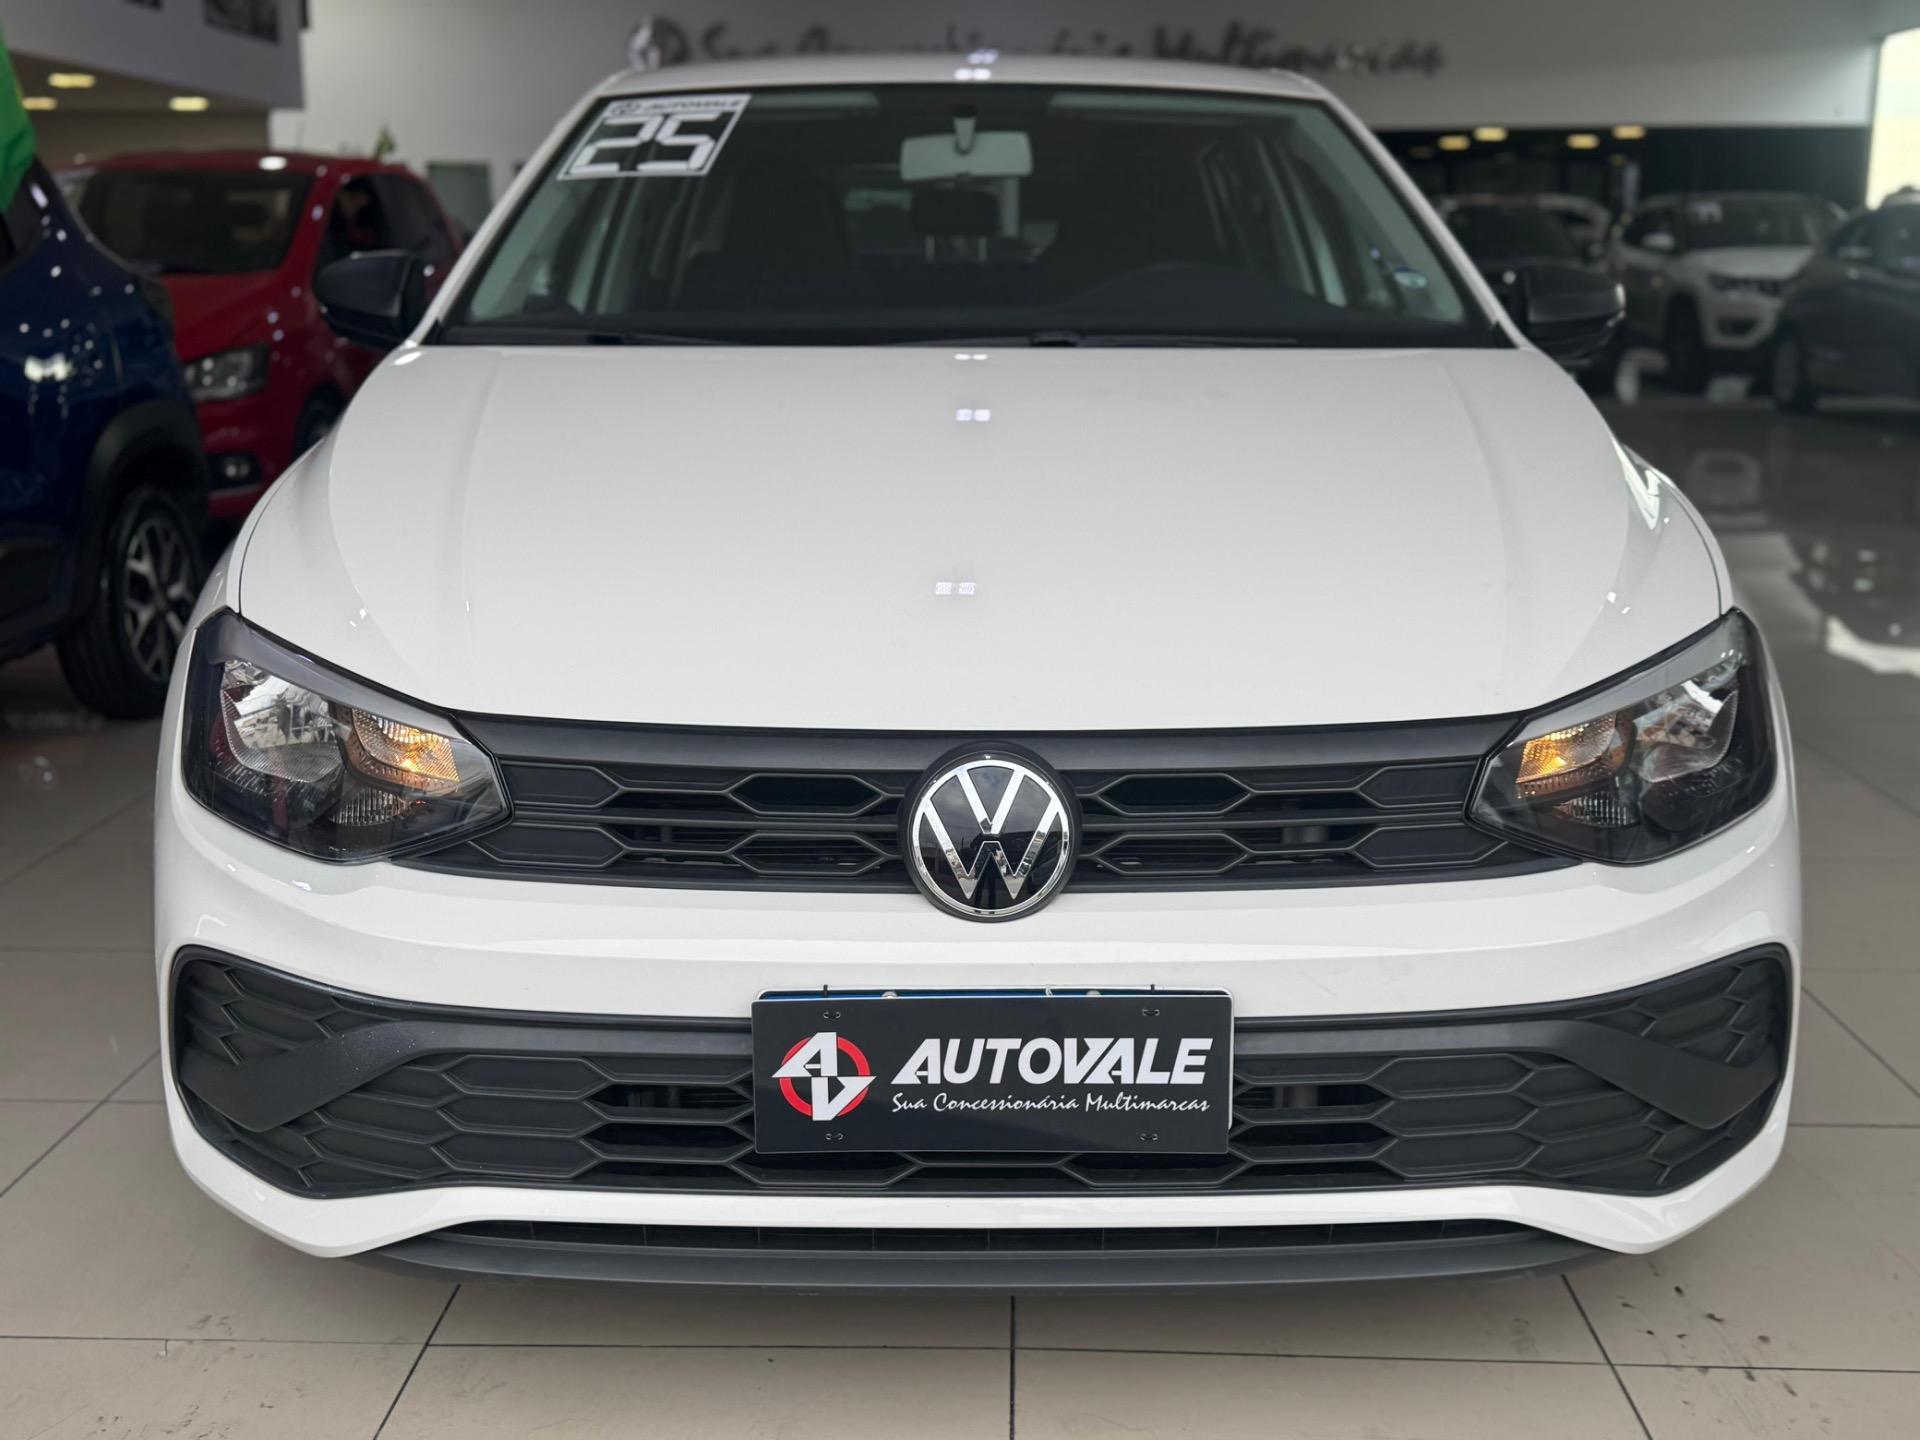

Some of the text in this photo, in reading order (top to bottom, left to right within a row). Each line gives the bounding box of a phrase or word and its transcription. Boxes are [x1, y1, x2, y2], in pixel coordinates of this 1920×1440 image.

[569, 112, 721, 175] 25
[890, 1037, 1214, 1085] AUTOVALE
[892, 1091, 1210, 1113] Sua Concessionária Multimarcas
